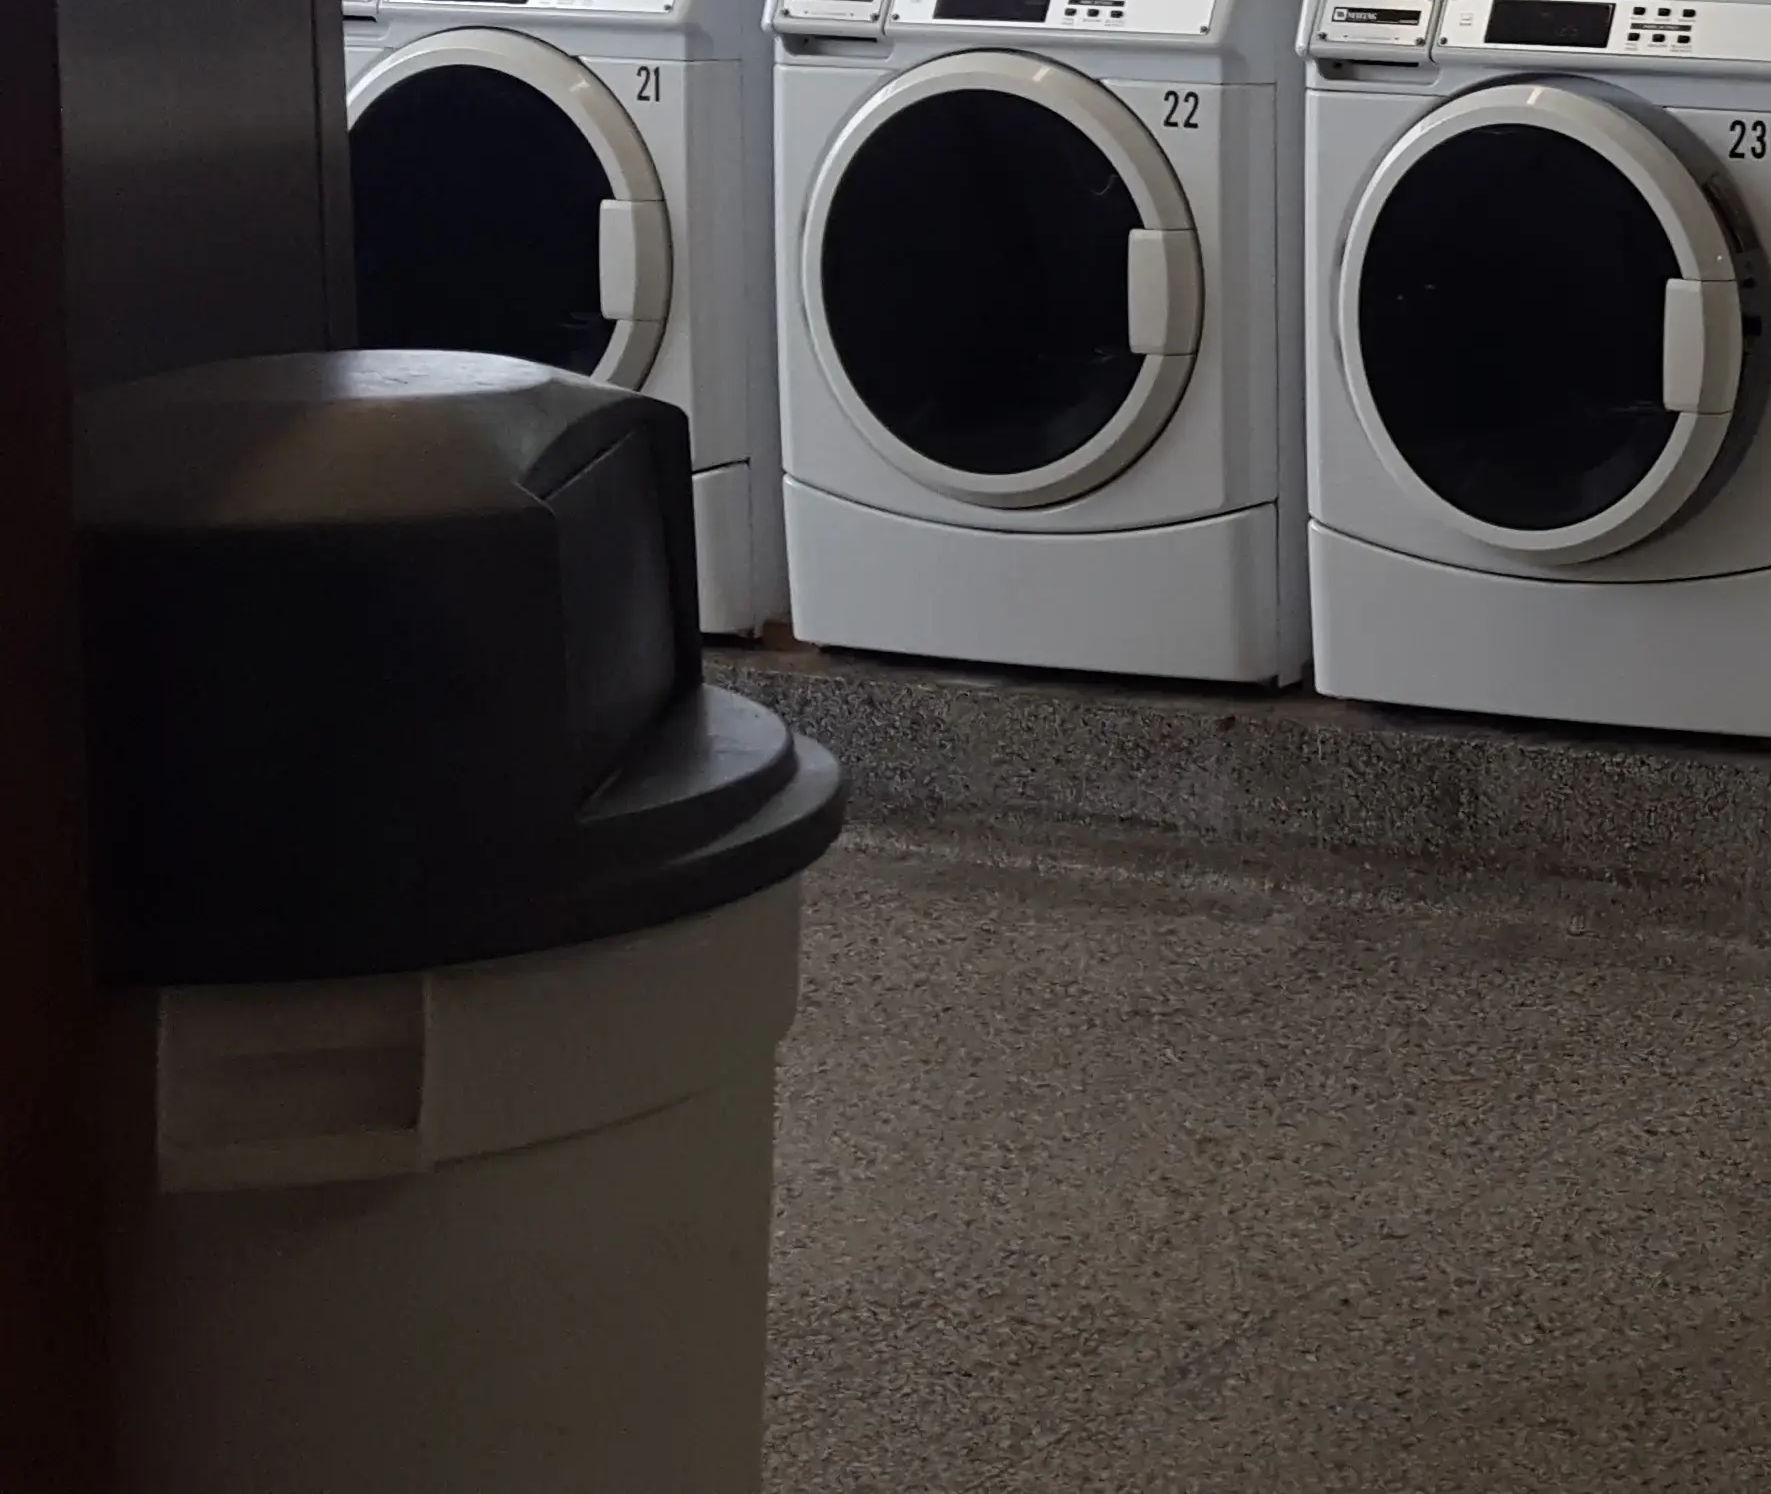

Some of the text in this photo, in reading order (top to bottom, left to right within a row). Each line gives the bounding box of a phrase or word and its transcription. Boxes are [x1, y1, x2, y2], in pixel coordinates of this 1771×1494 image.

[635, 65, 661, 103] 21
[1163, 90, 1200, 129] 22
[1728, 120, 1767, 160] 23
